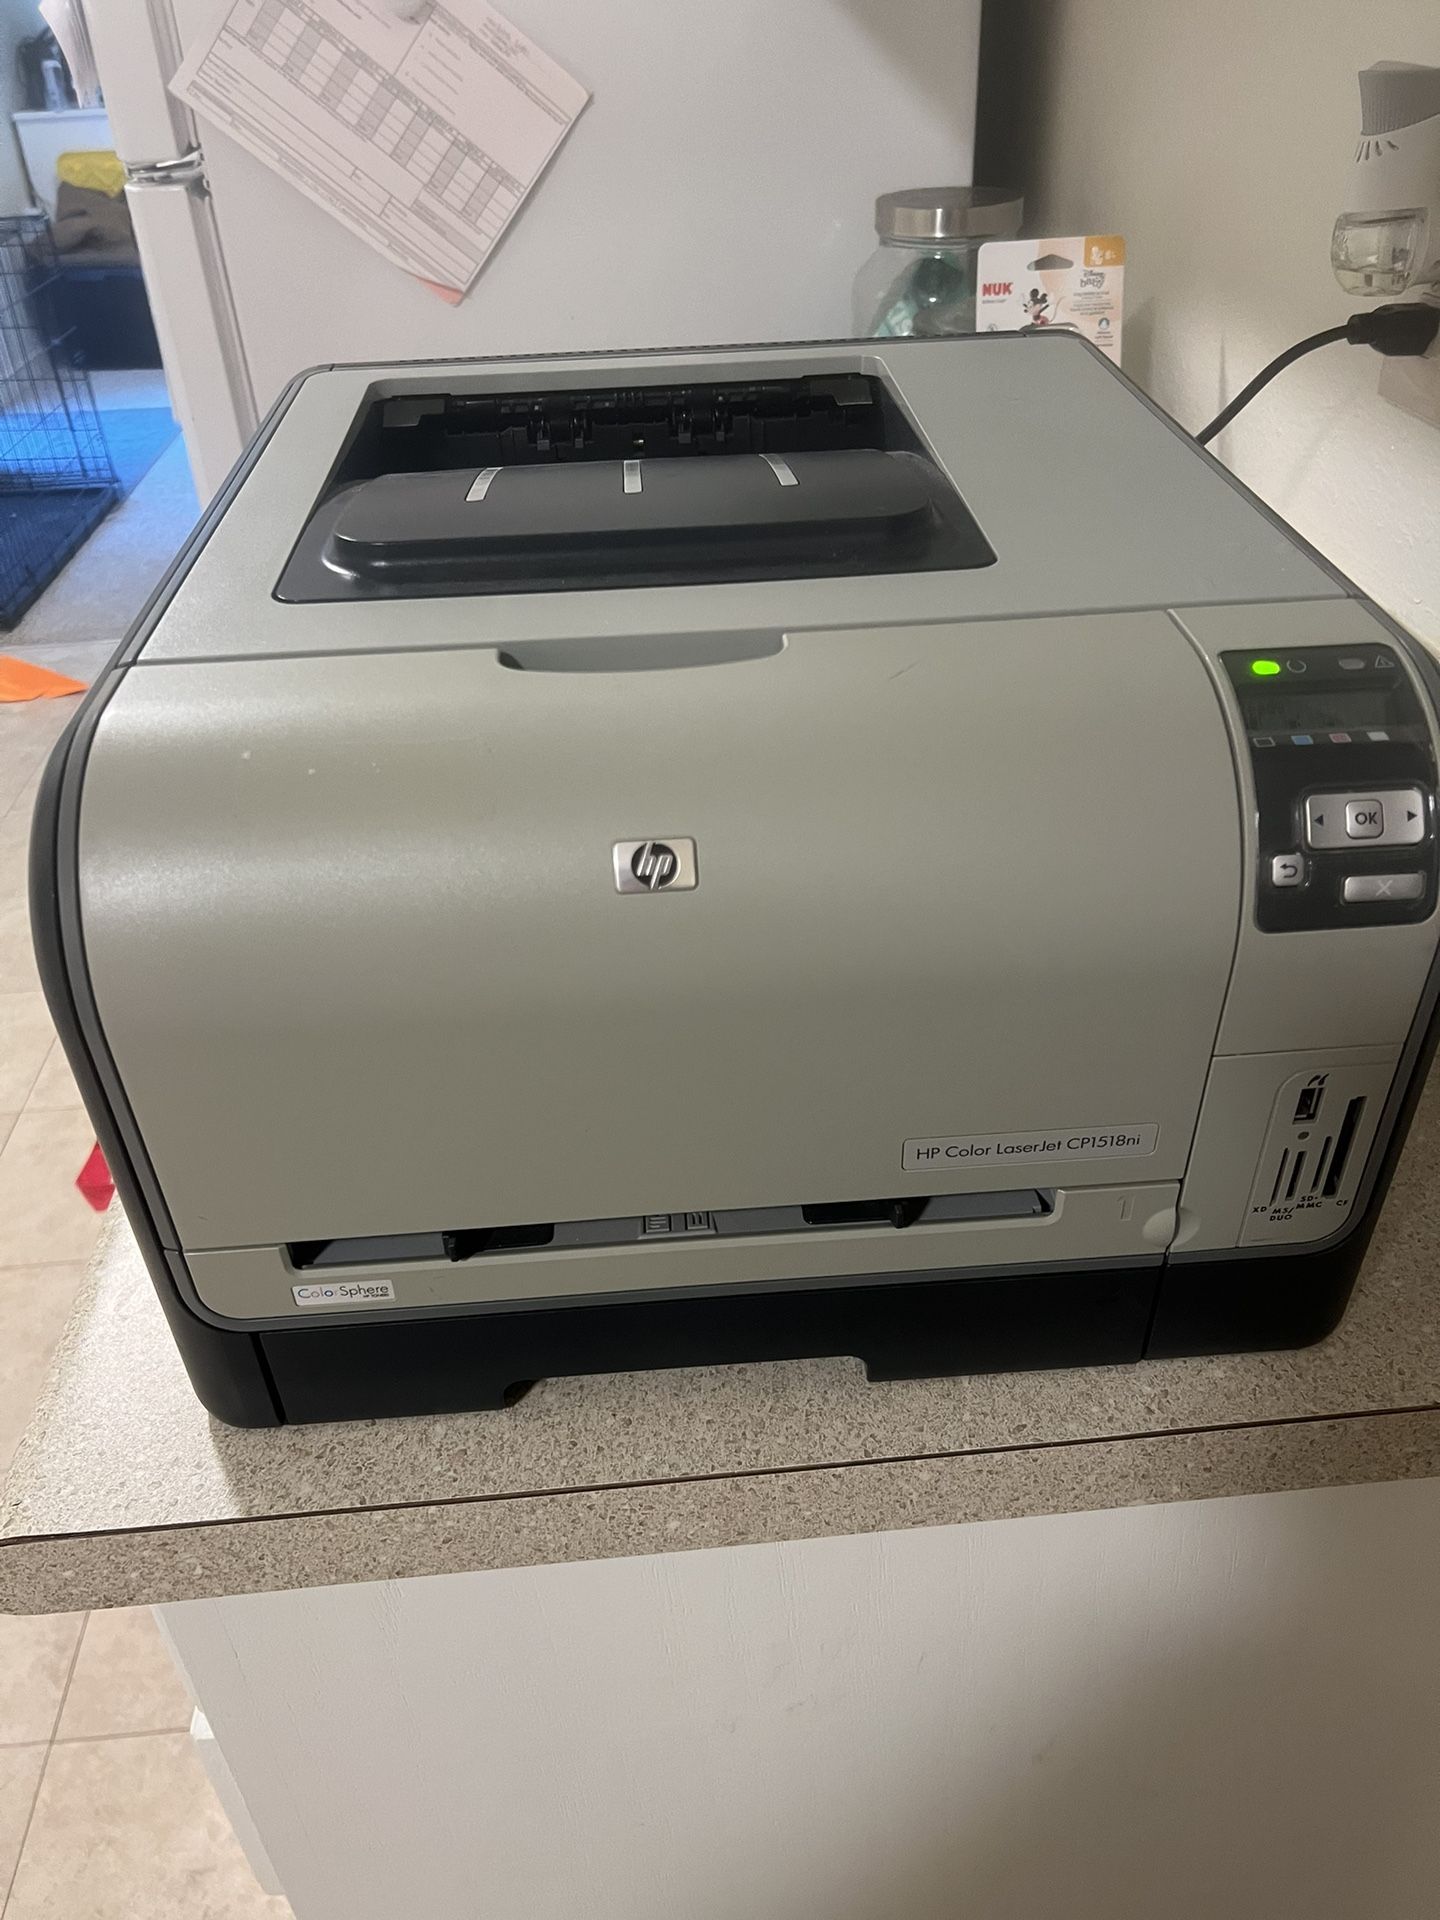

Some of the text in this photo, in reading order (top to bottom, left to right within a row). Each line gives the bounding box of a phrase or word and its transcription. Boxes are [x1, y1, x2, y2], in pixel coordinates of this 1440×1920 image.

[982, 282, 1013, 296] NUK
[1355, 811, 1378, 825] OK
[916, 1134, 1141, 1160] HP Color LaserJet CP1518ni
[1296, 1201, 1322, 1209] MMC
